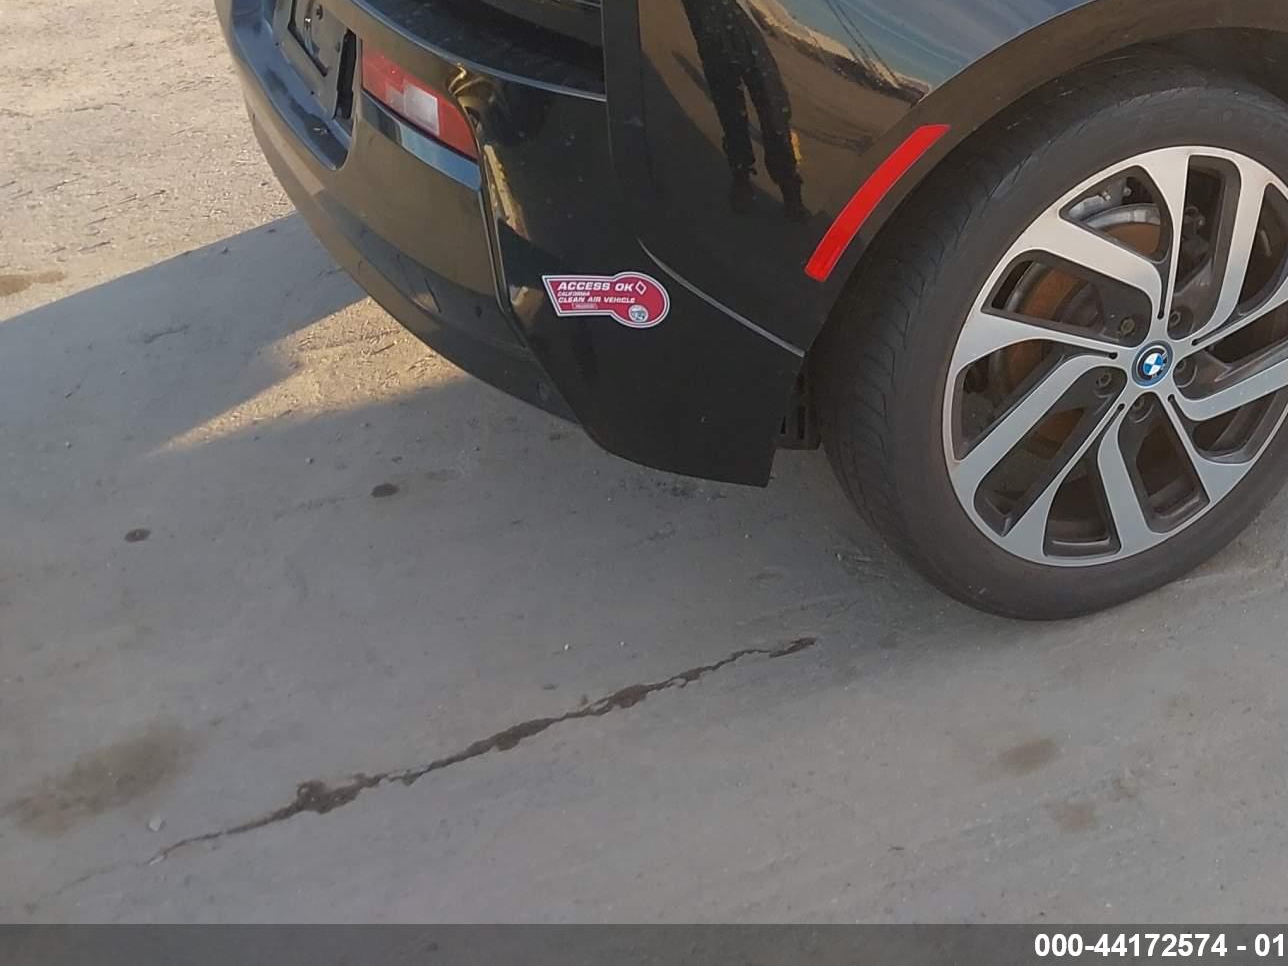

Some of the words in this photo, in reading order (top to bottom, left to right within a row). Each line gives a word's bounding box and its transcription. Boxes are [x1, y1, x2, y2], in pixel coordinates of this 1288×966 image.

[557, 281, 611, 291] ACCESS
[615, 282, 634, 292] OK
[603, 296, 636, 304] VEHICLE
